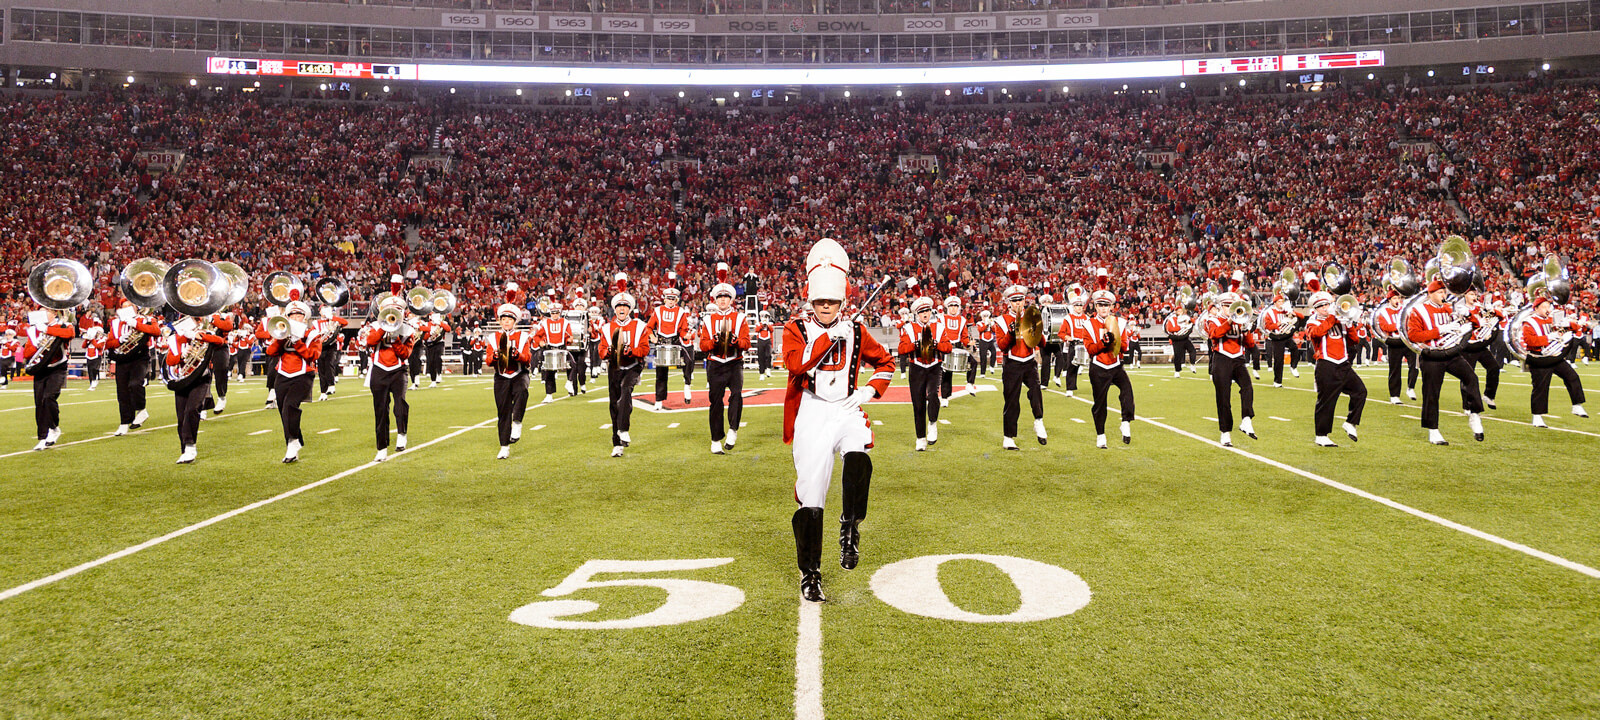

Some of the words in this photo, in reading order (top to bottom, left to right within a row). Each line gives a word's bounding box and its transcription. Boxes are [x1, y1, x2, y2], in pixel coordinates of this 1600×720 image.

[448, 15, 480, 25] 1953
[502, 17, 534, 26] 1960
[555, 18, 586, 27] 1963
[608, 20, 638, 29] 1994
[907, 20, 943, 28] 2000
[963, 19, 988, 27] 2011
[1012, 17, 1041, 26] 2012
[1063, 16, 1093, 24] 2013
[660, 21, 690, 29] 1999
[728, 21, 778, 31] ROSE
[817, 21, 870, 31] BOWL
[662, 310, 675, 322] W
